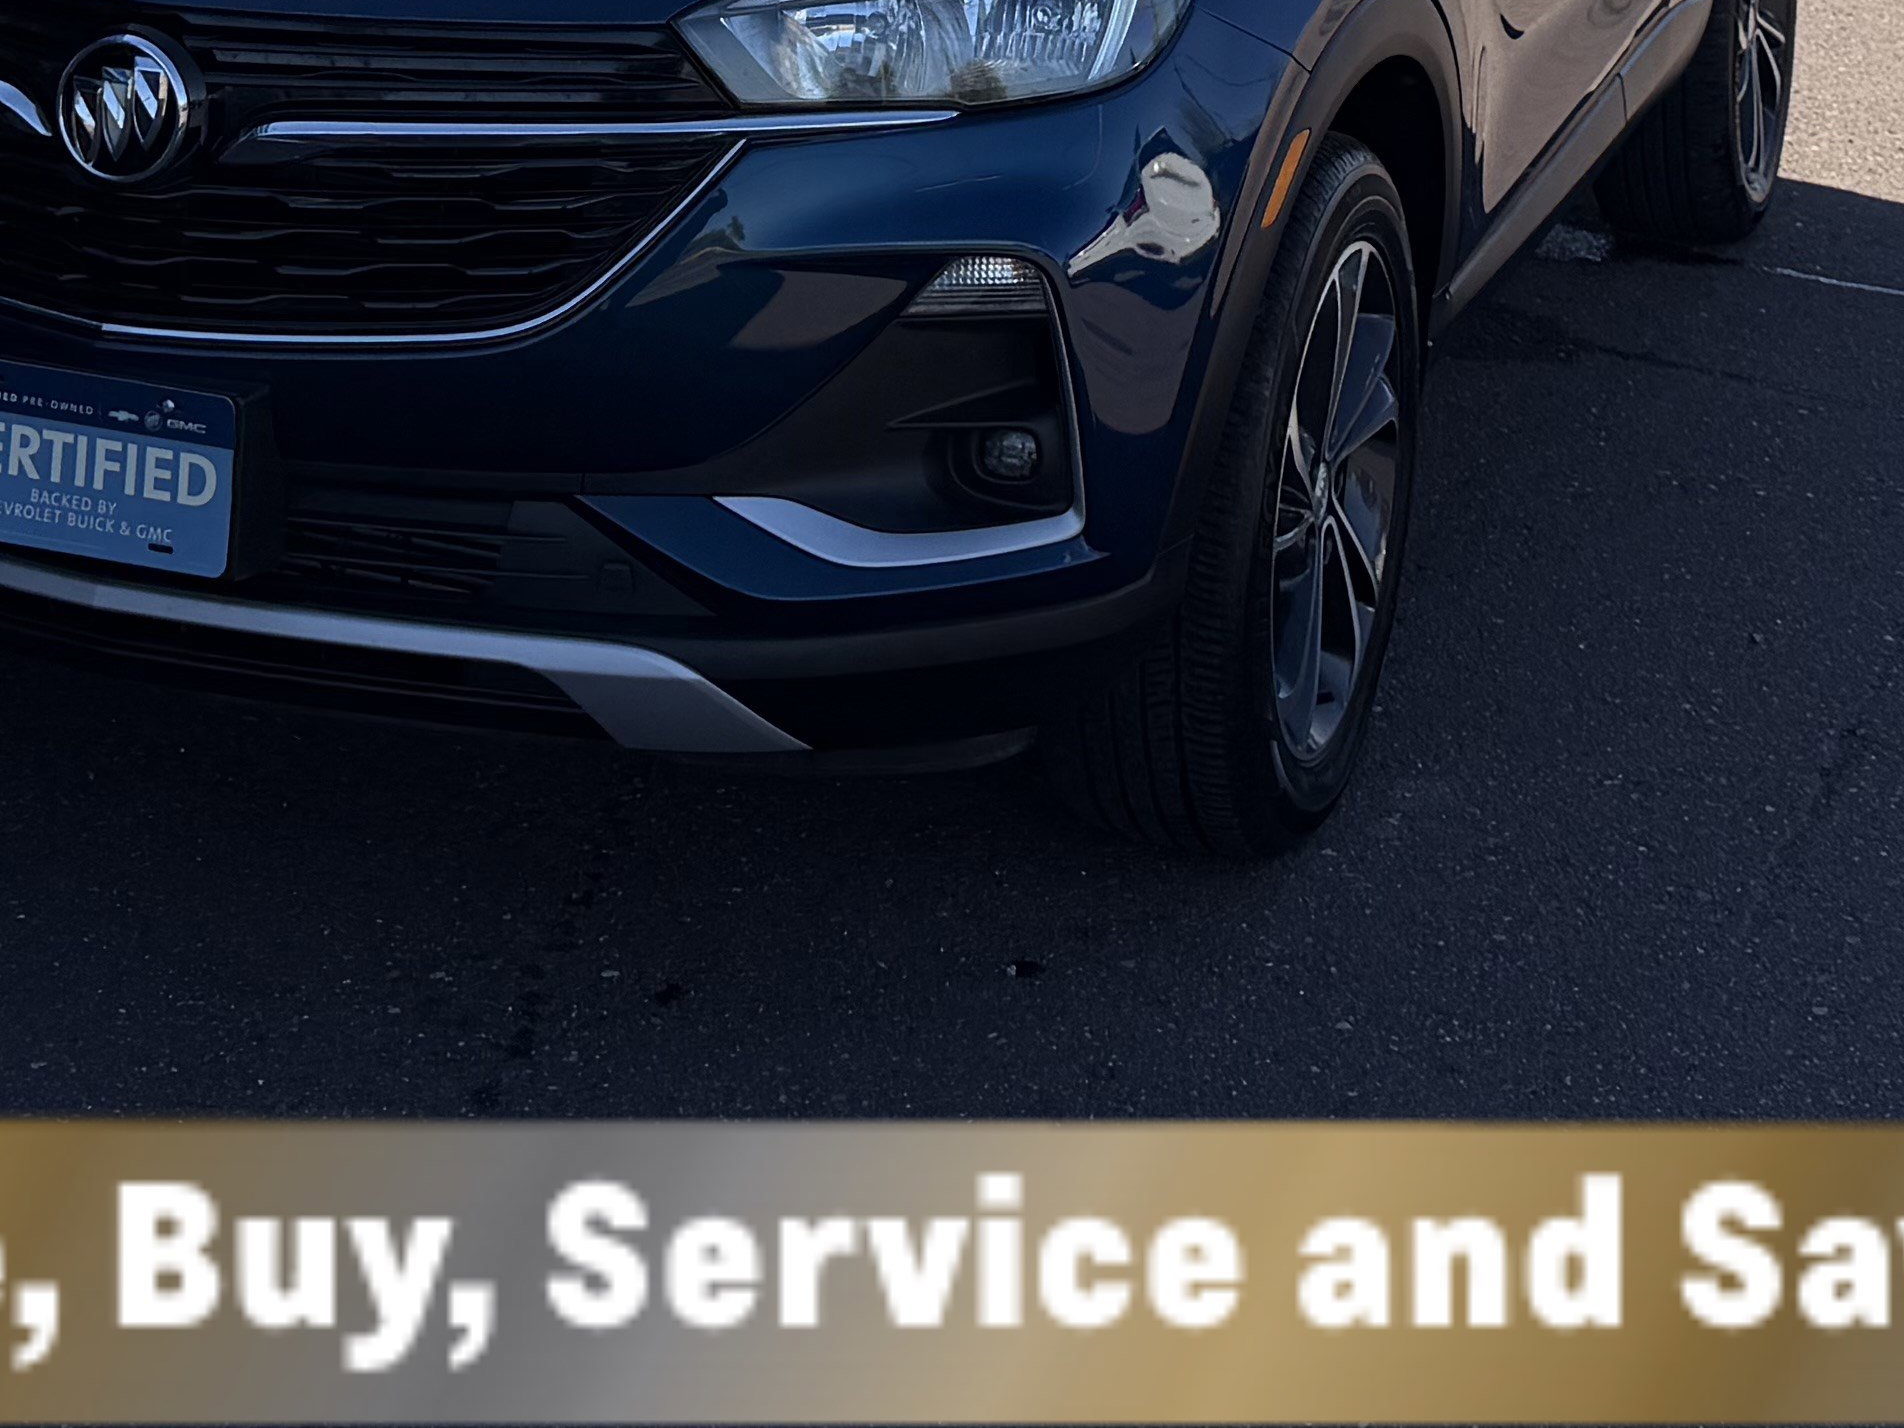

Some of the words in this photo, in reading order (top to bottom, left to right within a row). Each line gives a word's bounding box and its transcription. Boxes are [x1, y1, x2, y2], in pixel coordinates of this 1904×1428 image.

[166, 418, 207, 435] GMC
[30, 487, 92, 512] BACKED
[97, 499, 117, 516] BY
[67, 512, 115, 534] BUICK
[119, 521, 131, 537] &
[136, 524, 173, 544] GMC
